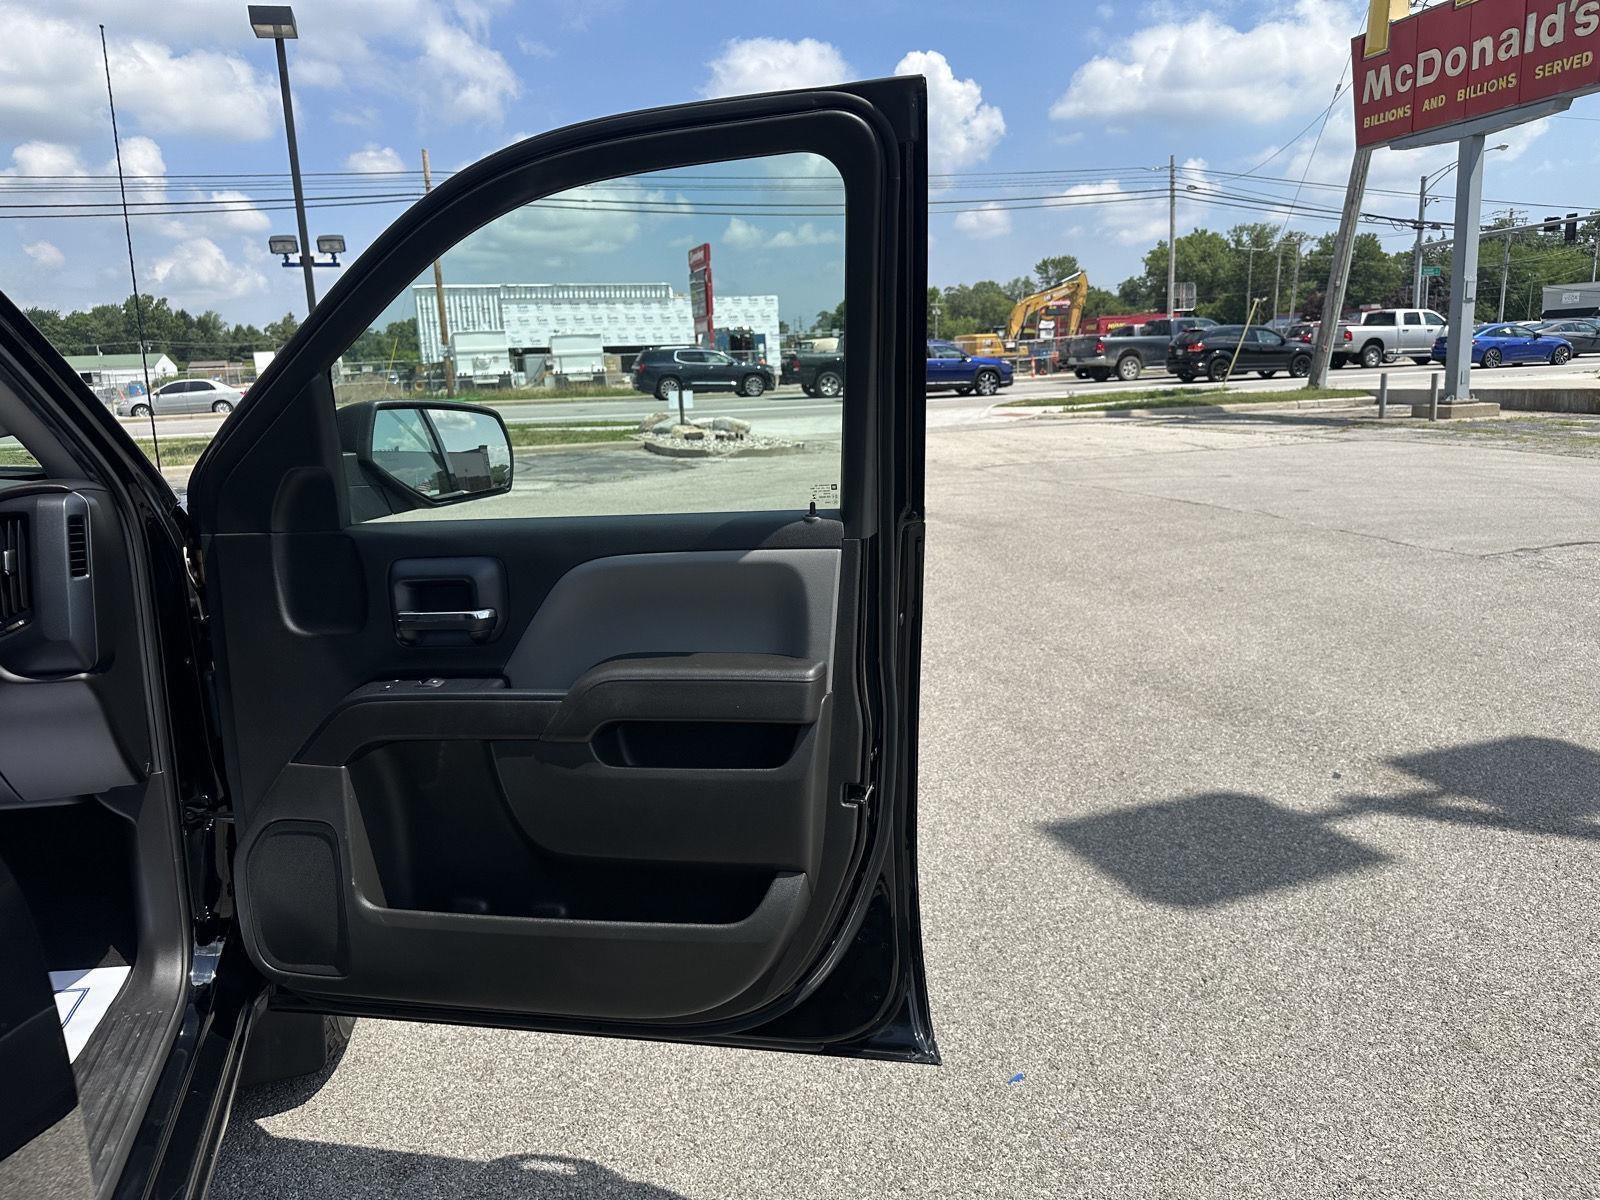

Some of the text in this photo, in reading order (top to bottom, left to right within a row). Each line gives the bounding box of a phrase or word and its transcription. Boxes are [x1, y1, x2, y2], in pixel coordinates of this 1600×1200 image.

[1362, 0, 1600, 104] McDonald's
[1363, 51, 1594, 128] BILLIONS AND BILLIONS SERVED
